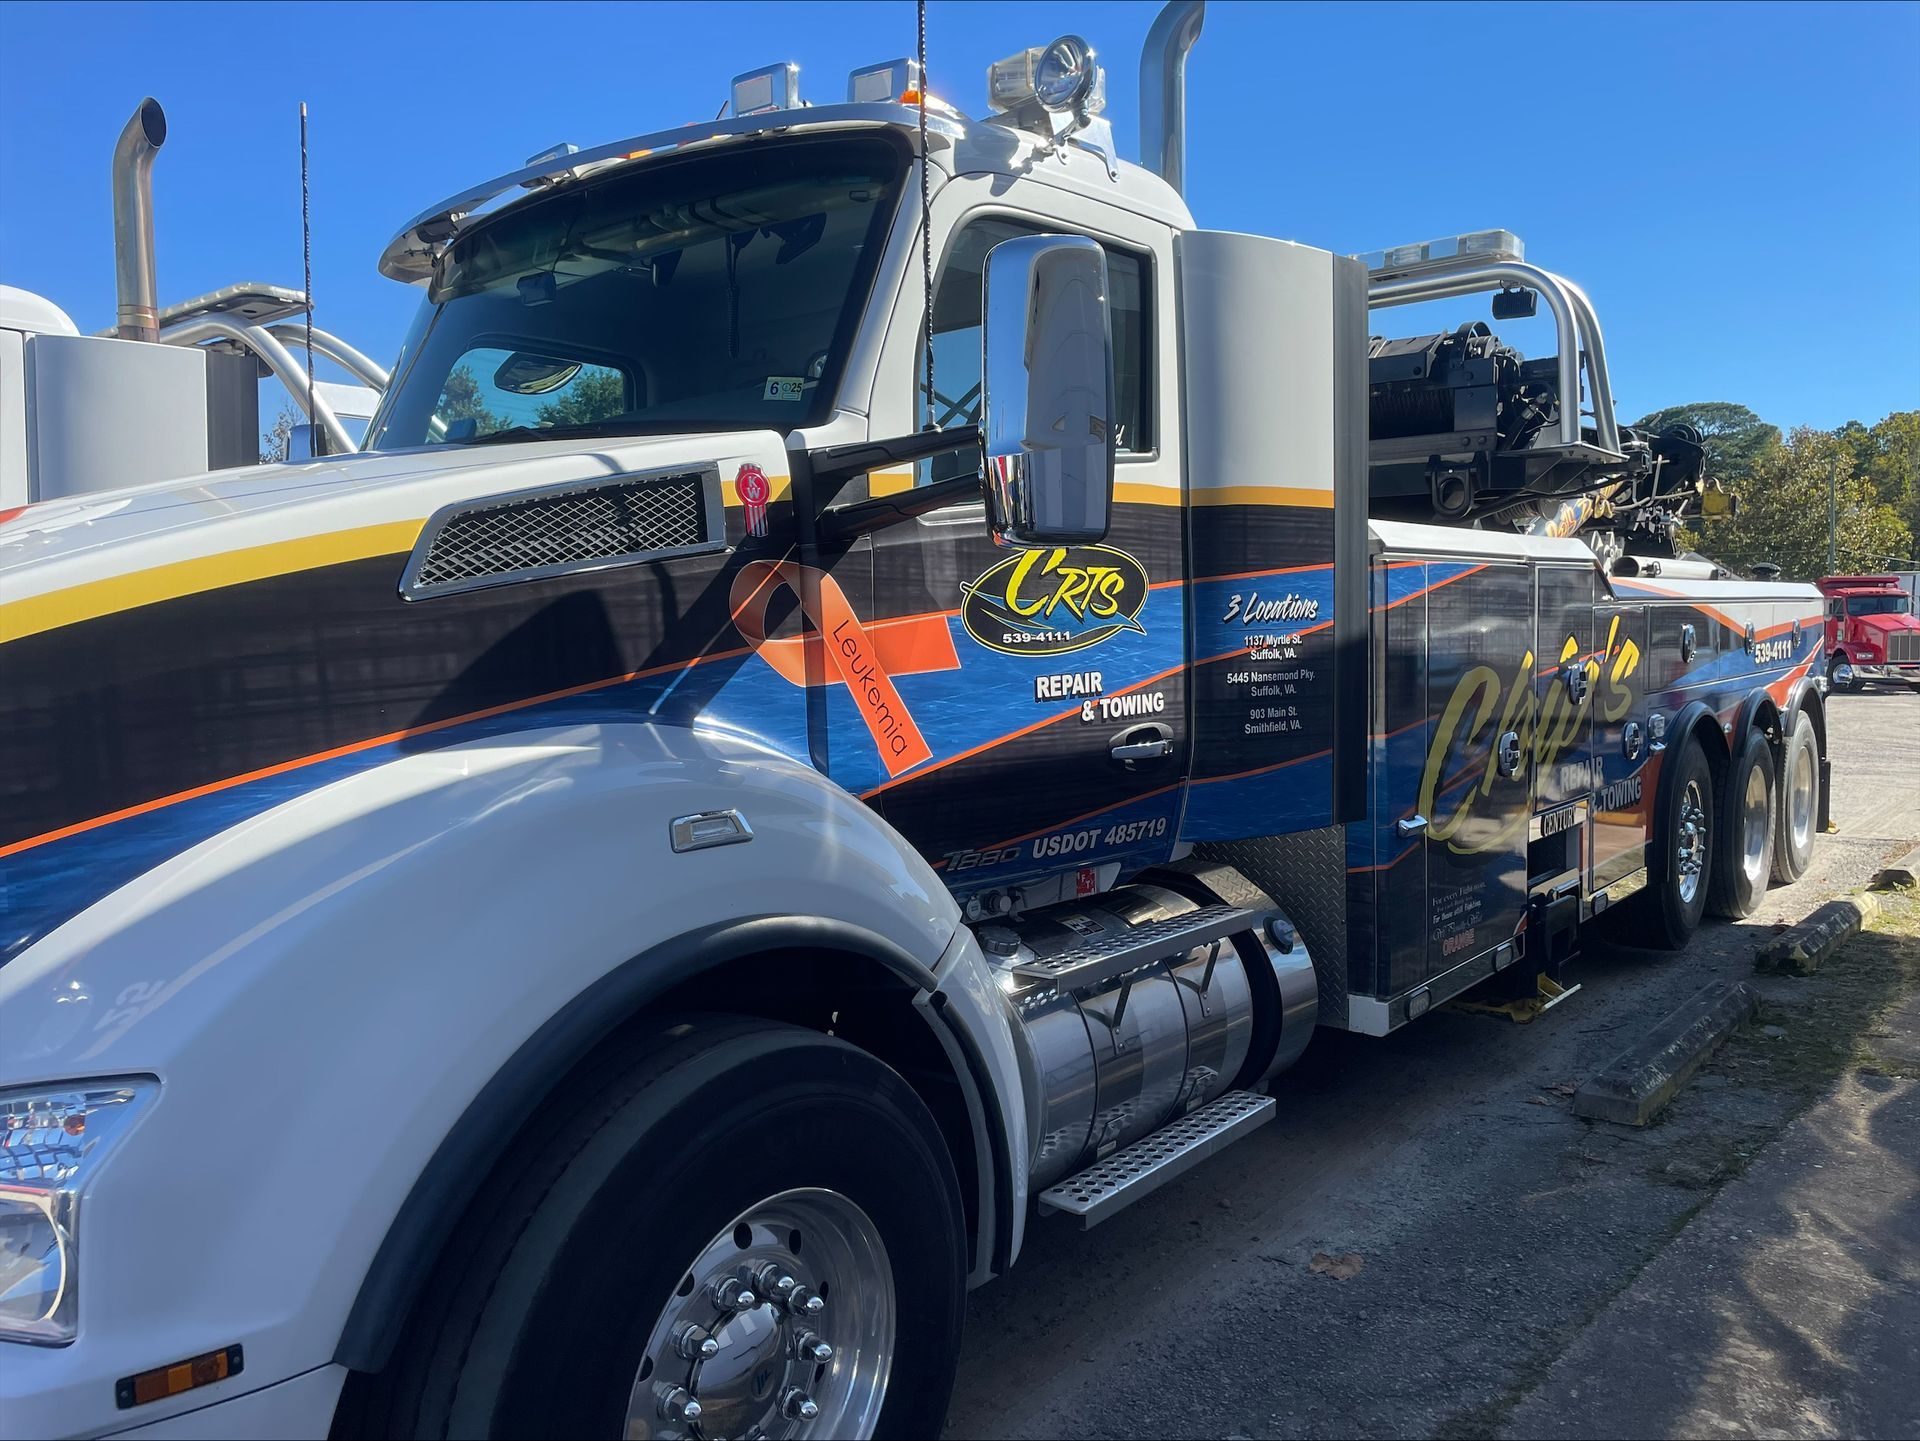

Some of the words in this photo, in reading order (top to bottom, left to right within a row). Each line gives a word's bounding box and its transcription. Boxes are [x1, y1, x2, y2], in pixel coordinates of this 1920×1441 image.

[770, 381, 779, 395] 6
[791, 382, 803, 393] 25
[1223, 594, 1242, 621] 3
[1243, 592, 1319, 623] Locations
[1002, 631, 1071, 644] 539-4111
[1244, 635, 1264, 647] 1137
[1266, 635, 1291, 648] Myrtle
[1292, 634, 1303, 644] St.
[1250, 649, 1283, 660] Suffolk,
[1284, 648, 1298, 659] VA.
[1755, 639, 1792, 664] 539-4111
[832, 619, 909, 757] Leukemia
[1035, 671, 1103, 700] REPAIR
[1227, 672, 1249, 684] 5445
[1251, 670, 1299, 682] Nansemond
[1300, 669, 1316, 681] Pky.
[1251, 685, 1283, 697] Suffolk,
[1284, 684, 1297, 695] VA.
[1081, 700, 1096, 722] &
[1099, 692, 1165, 720] TOWING
[1250, 708, 1265, 720] 903
[1267, 707, 1286, 718] Main
[1288, 706, 1298, 716] St.
[1244, 721, 1289, 735] Smithfield,
[1290, 719, 1303, 730] VA.
[1418, 615, 1641, 852] Chip's
[1561, 756, 1605, 793] REPAIR
[1601, 776, 1642, 812] TOWING
[1032, 829, 1102, 859] USDOT
[1104, 817, 1167, 846] 485719
[943, 847, 1022, 872] T880
